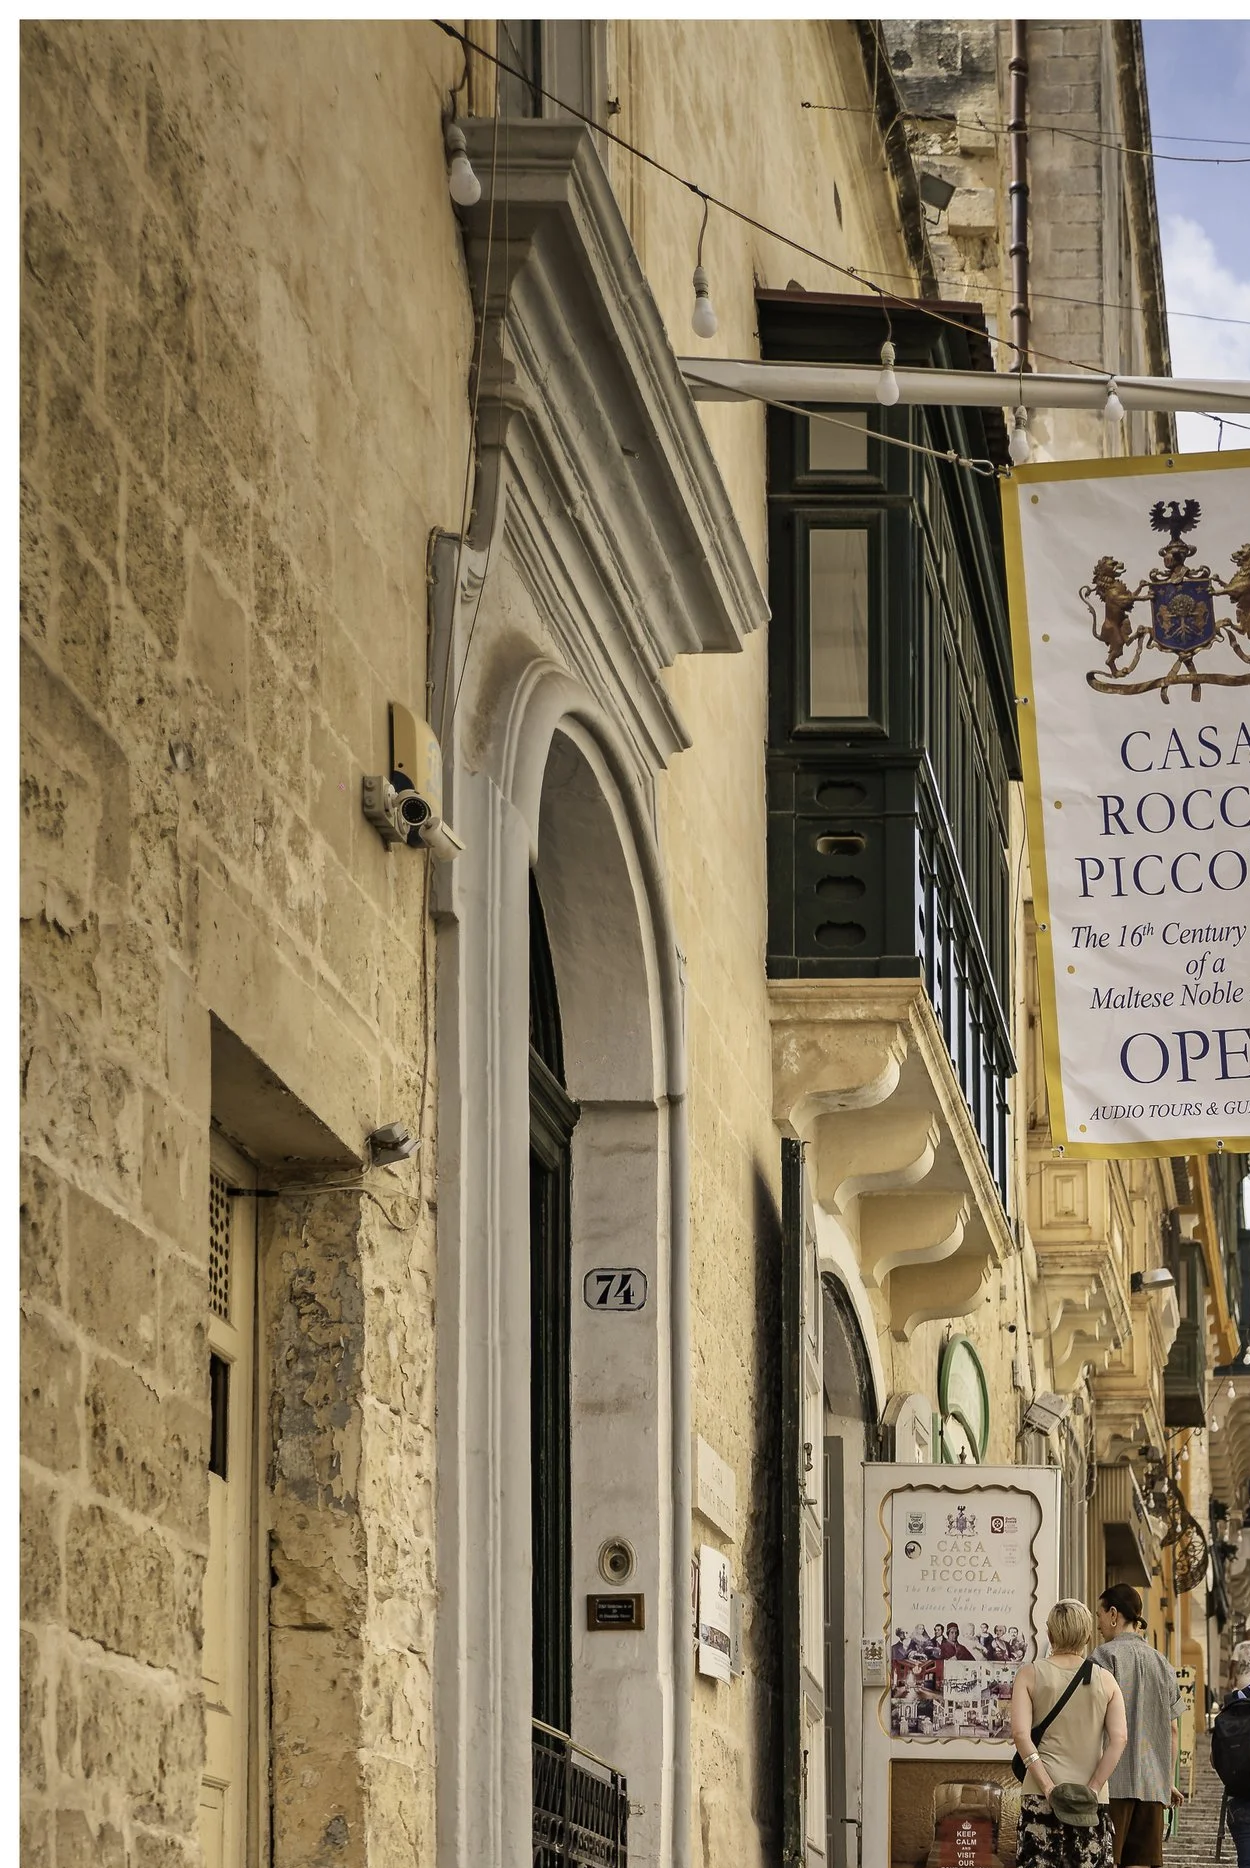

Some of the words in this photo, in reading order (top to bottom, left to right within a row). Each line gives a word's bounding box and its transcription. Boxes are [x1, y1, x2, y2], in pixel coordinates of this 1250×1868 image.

[1071, 926, 1110, 949] The
[1117, 922, 1155, 948] 16th
[1162, 922, 1247, 948] Century
[1185, 950, 1211, 981] of
[1212, 957, 1226, 974] a
[1090, 986, 1174, 1010] Maltese
[1180, 980, 1244, 1007] Noble
[1089, 1104, 1145, 1121] AUDIO
[1148, 1102, 1203, 1118] TOURS
[1205, 1101, 1220, 1116] &
[595, 1274, 636, 1305] 74
[936, 1541, 986, 1553] CASA
[929, 1554, 992, 1567] ROCCA
[920, 1569, 1001, 1582] PICCOLA
[946, 1586, 981, 1594] Century
[950, 1603, 977, 1611] Noble
[981, 1604, 1013, 1613] Family
